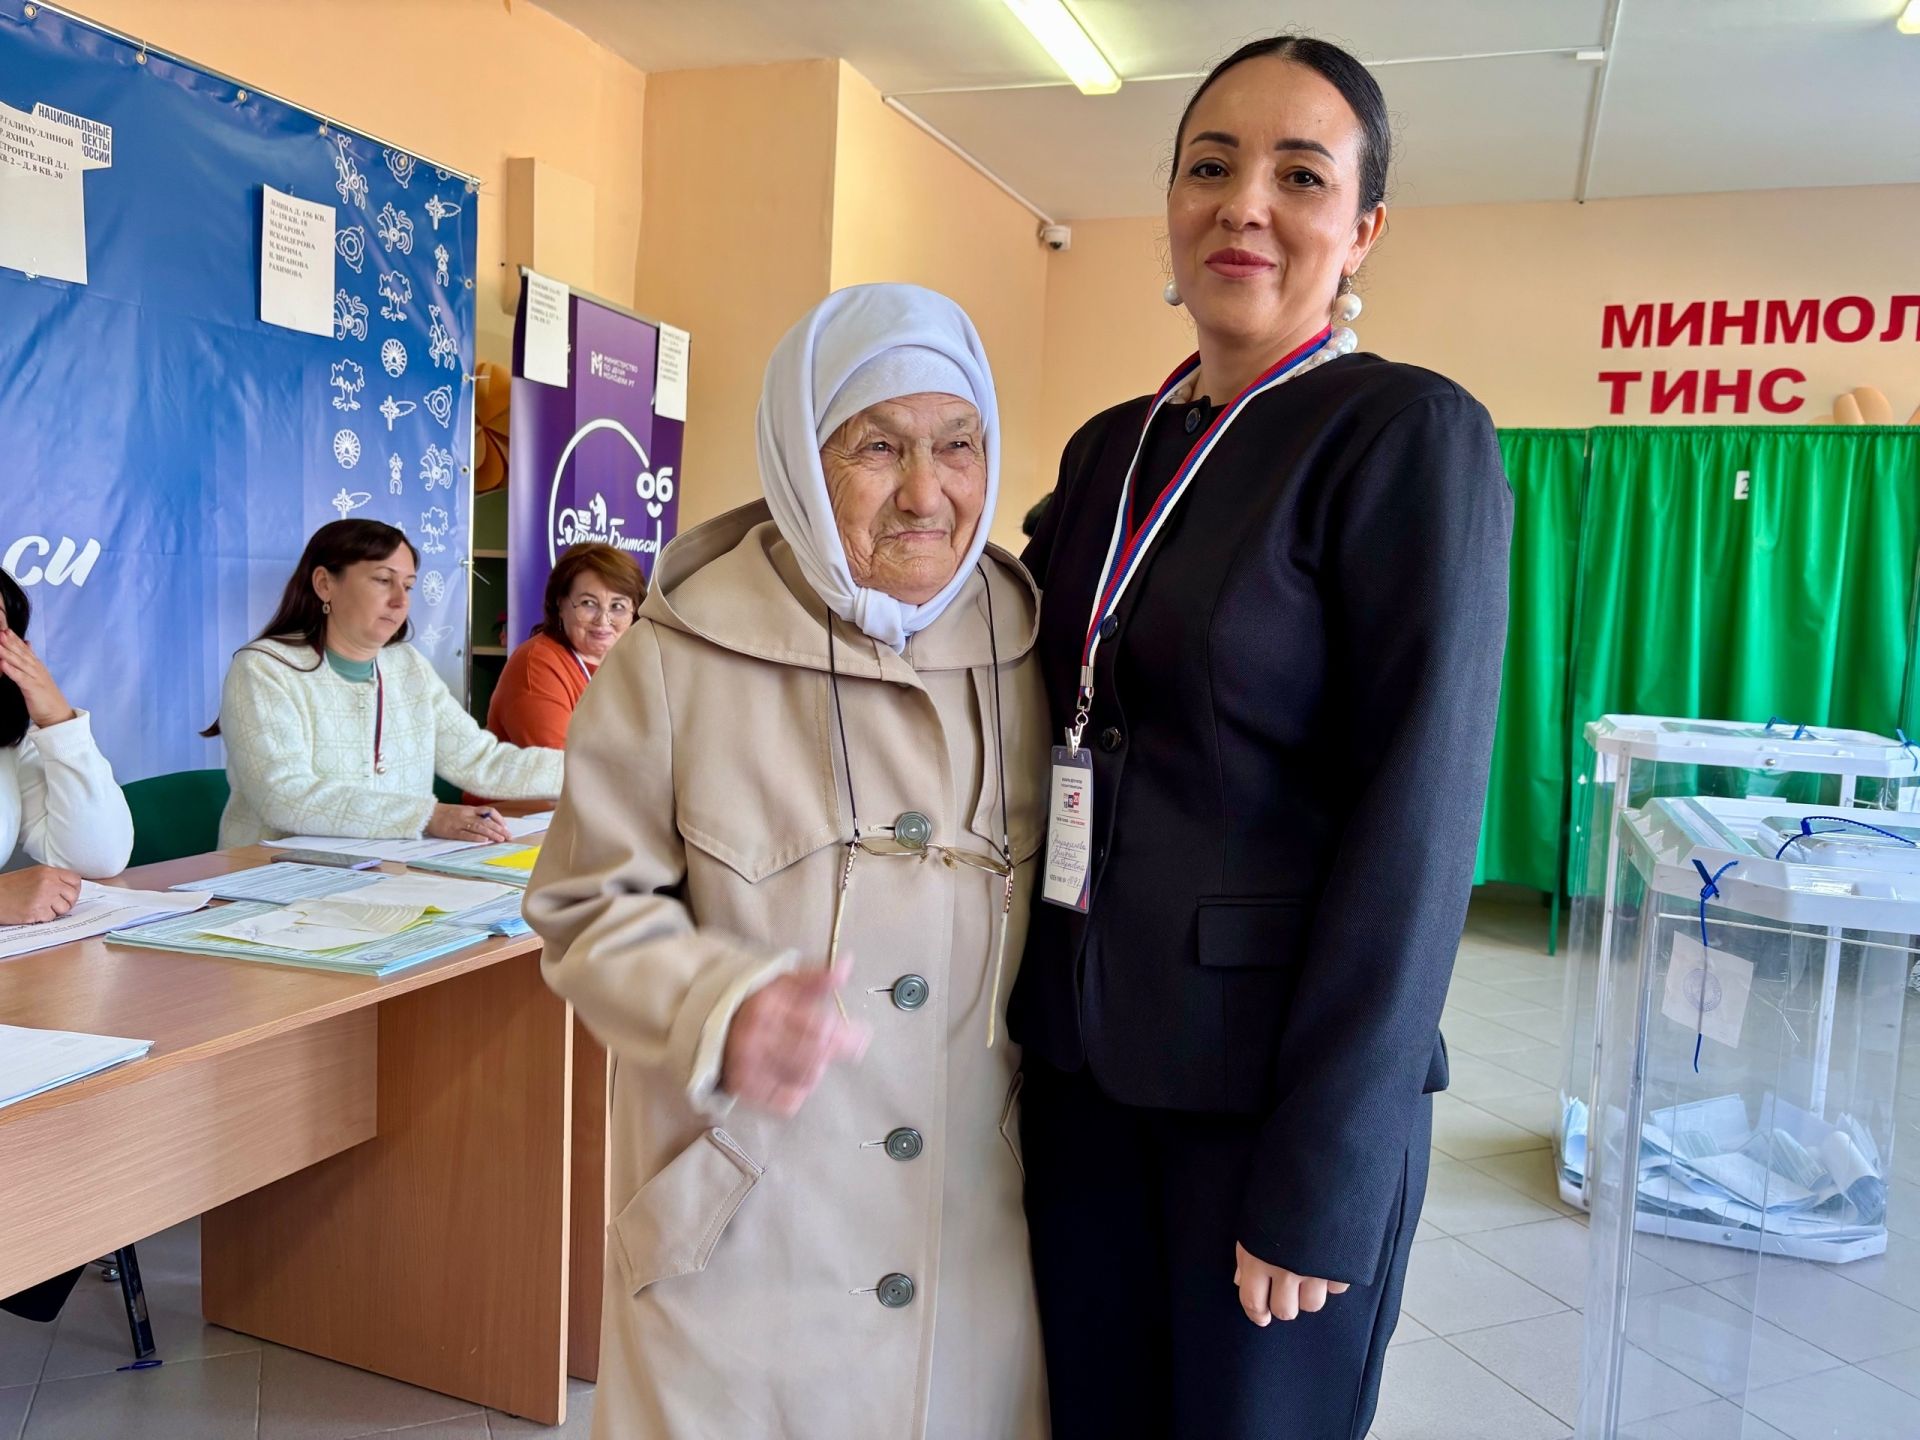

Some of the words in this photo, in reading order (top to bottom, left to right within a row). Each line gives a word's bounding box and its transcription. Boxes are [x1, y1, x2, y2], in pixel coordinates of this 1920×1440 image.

[38, 104, 110, 140] НАЦИОНАЛЬНЫЕ
[82, 132, 110, 152] ОЕКТЫ
[82, 145, 110, 165] ОССИИ
[1601, 295, 1920, 348] МИНМОЛ
[1598, 367, 1807, 415] ТИНС
